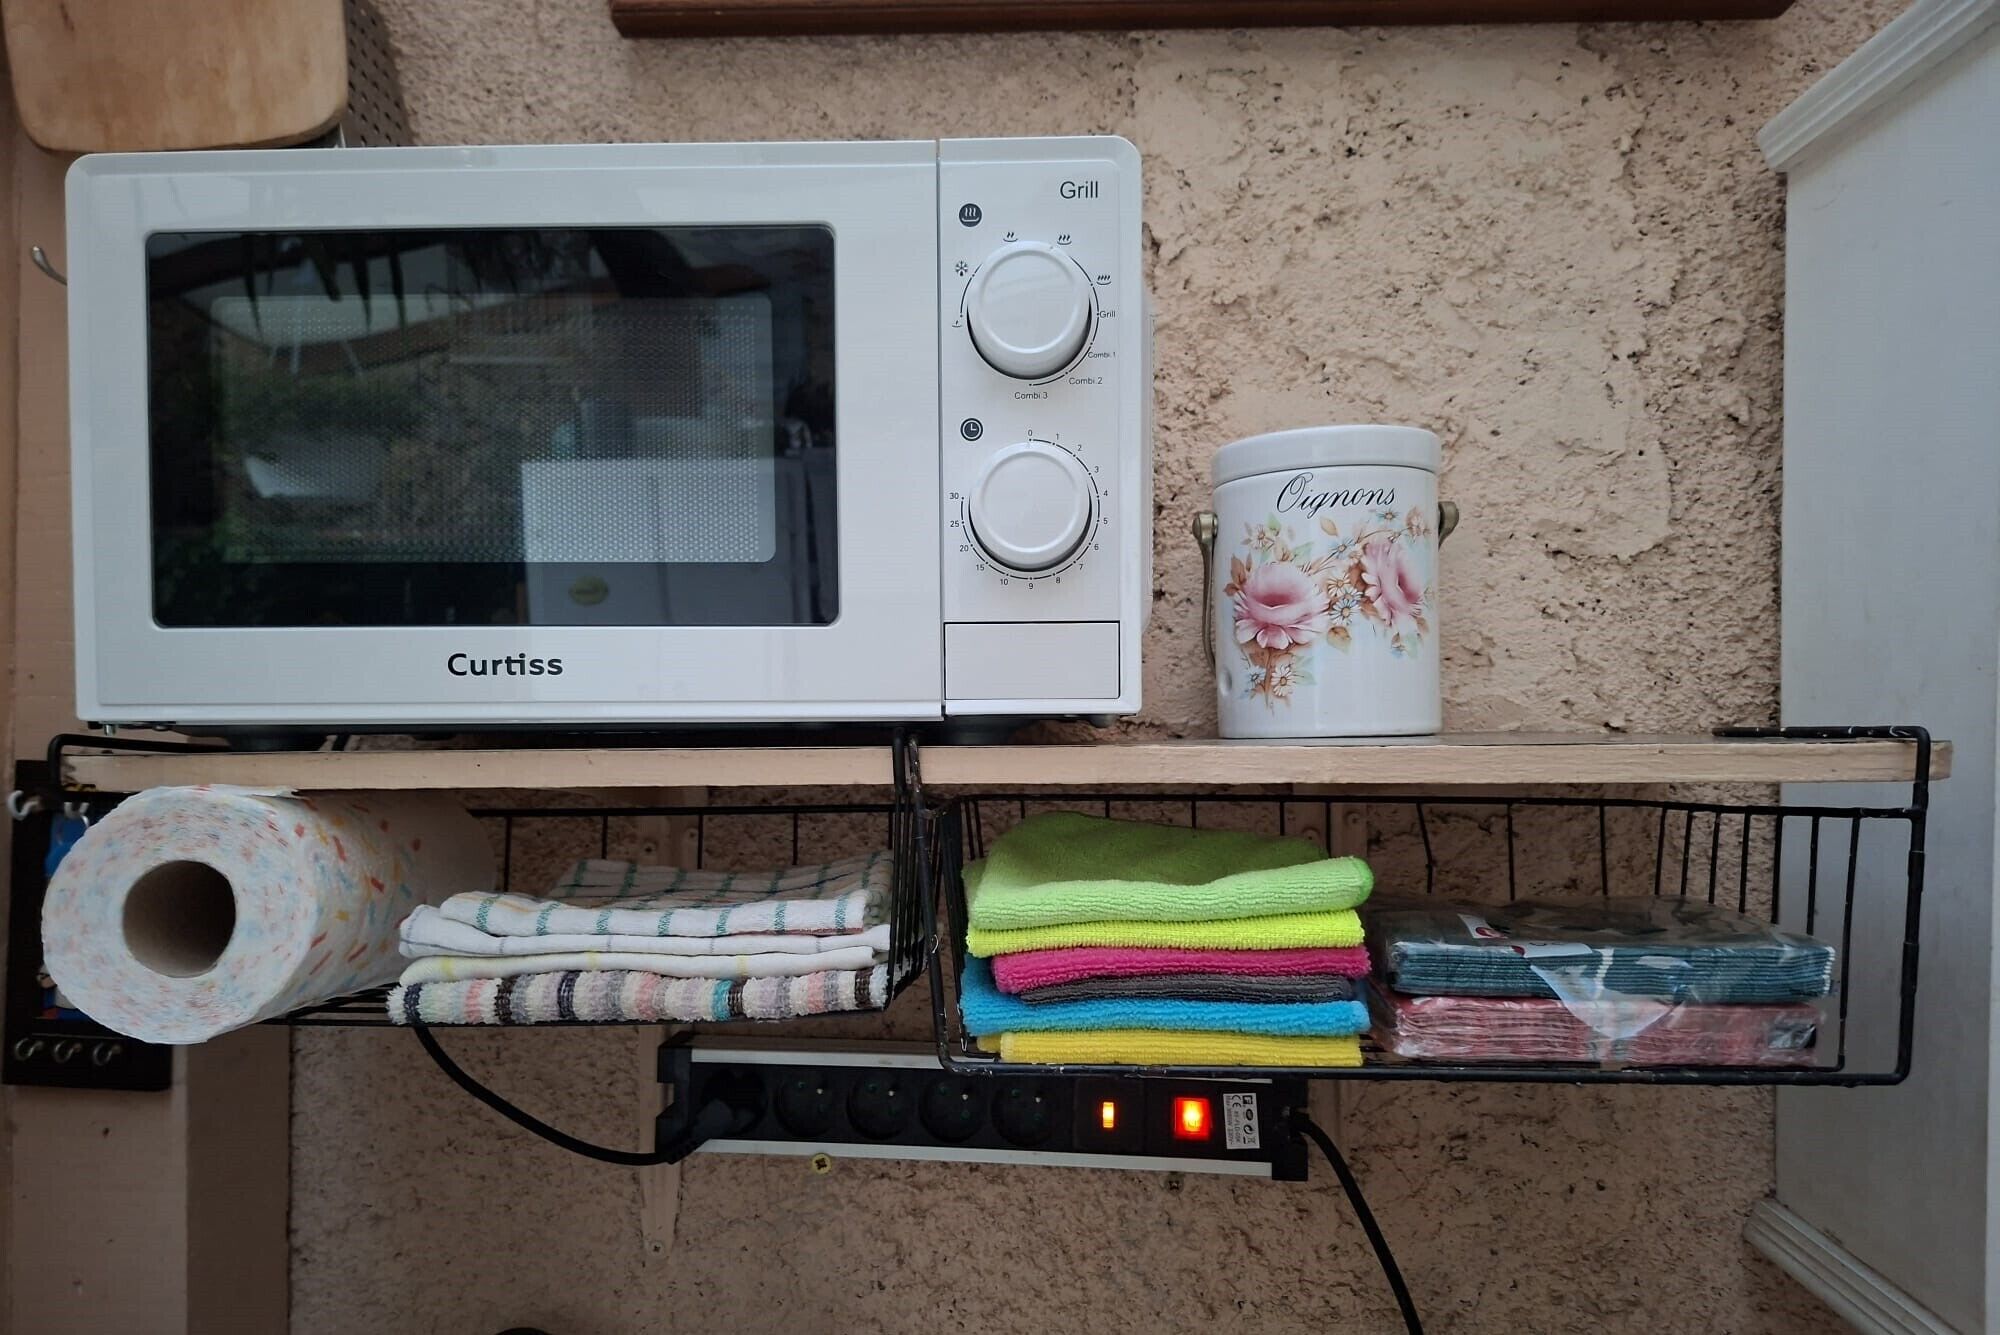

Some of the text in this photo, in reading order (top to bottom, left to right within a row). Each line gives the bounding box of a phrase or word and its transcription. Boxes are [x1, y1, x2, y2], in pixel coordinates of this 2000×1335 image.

[1060, 181, 1098, 199] Grill
[1077, 444, 1083, 452] 2
[1094, 466, 1100, 474] 3
[1276, 471, 1396, 520] Oignons
[950, 520, 960, 528] 25
[976, 564, 985, 572] 15
[448, 653, 562, 676] Curtiss
